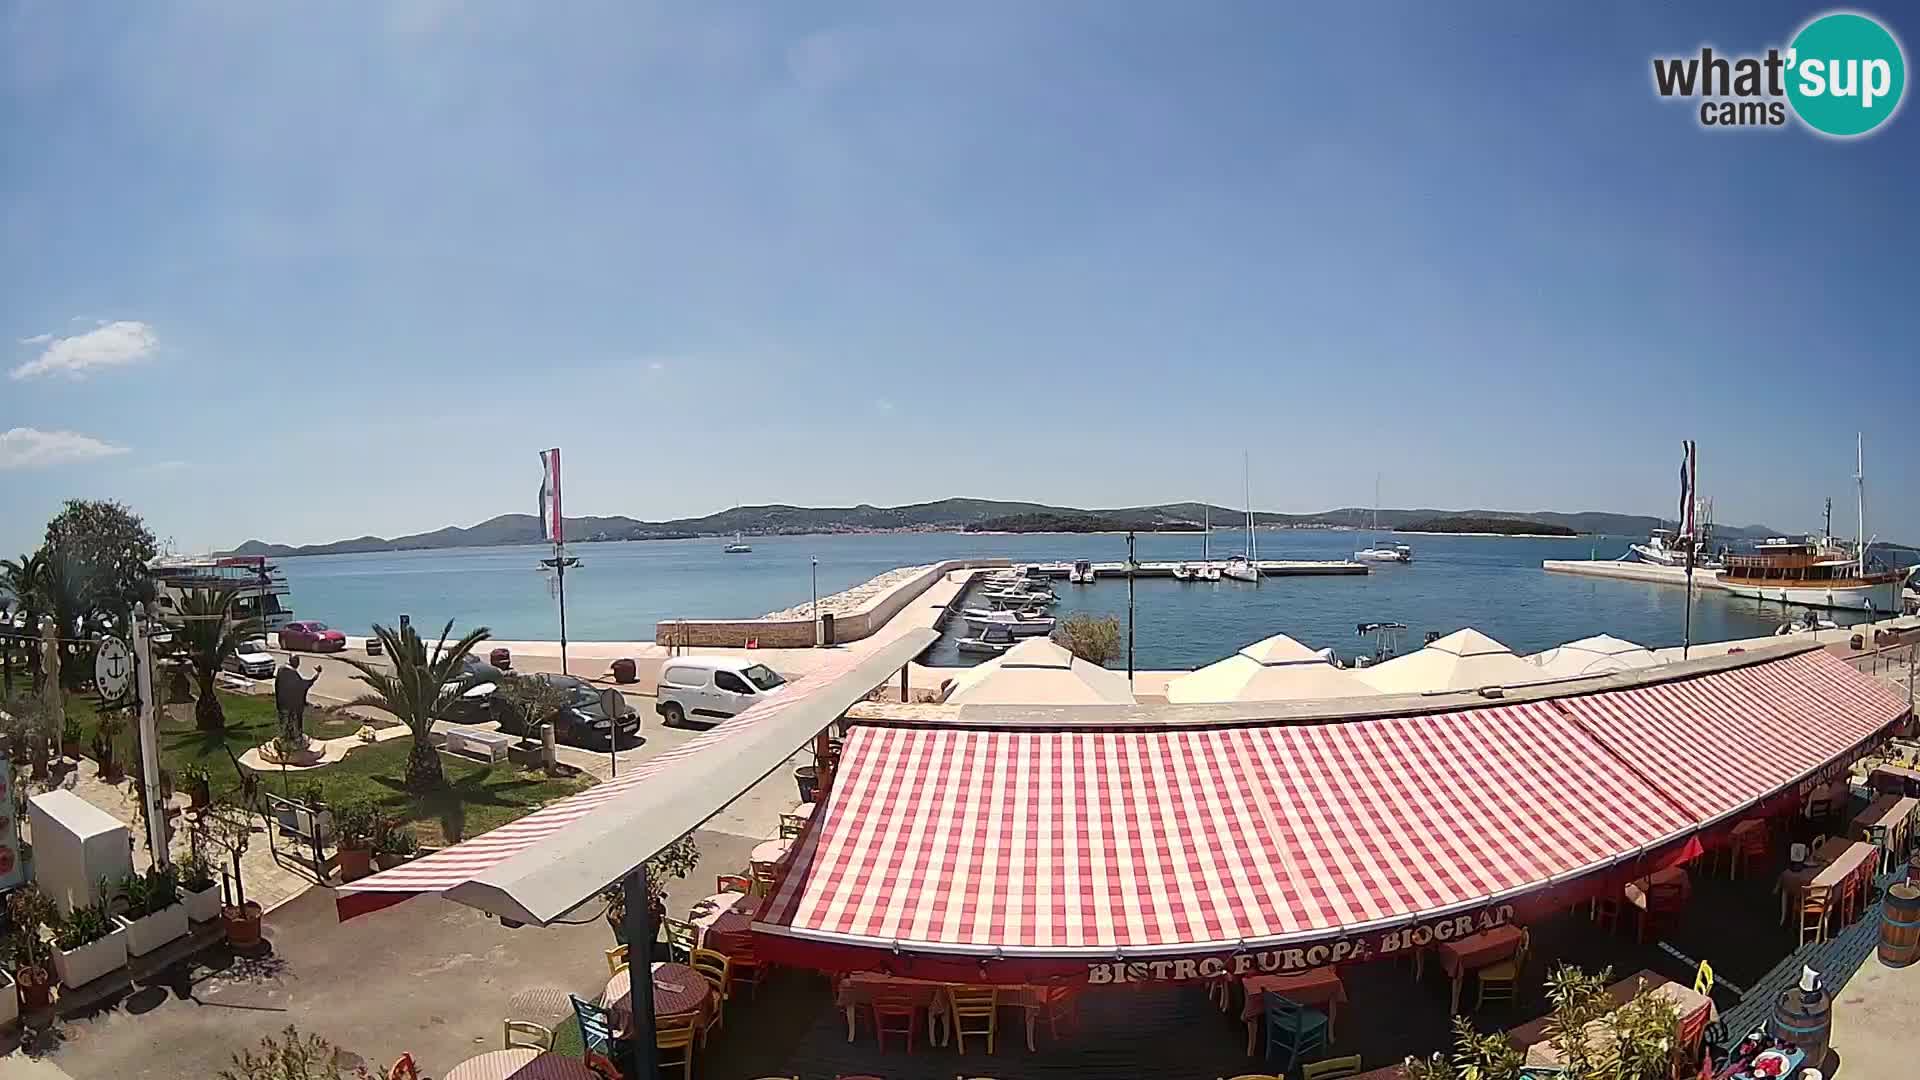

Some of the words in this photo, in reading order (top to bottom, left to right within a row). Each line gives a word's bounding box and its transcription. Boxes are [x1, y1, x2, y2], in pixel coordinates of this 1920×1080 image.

[1087, 957, 1226, 984] BISTRO
[1233, 939, 1370, 975] EUROPA
[1380, 904, 1514, 953] BIOGRAD
